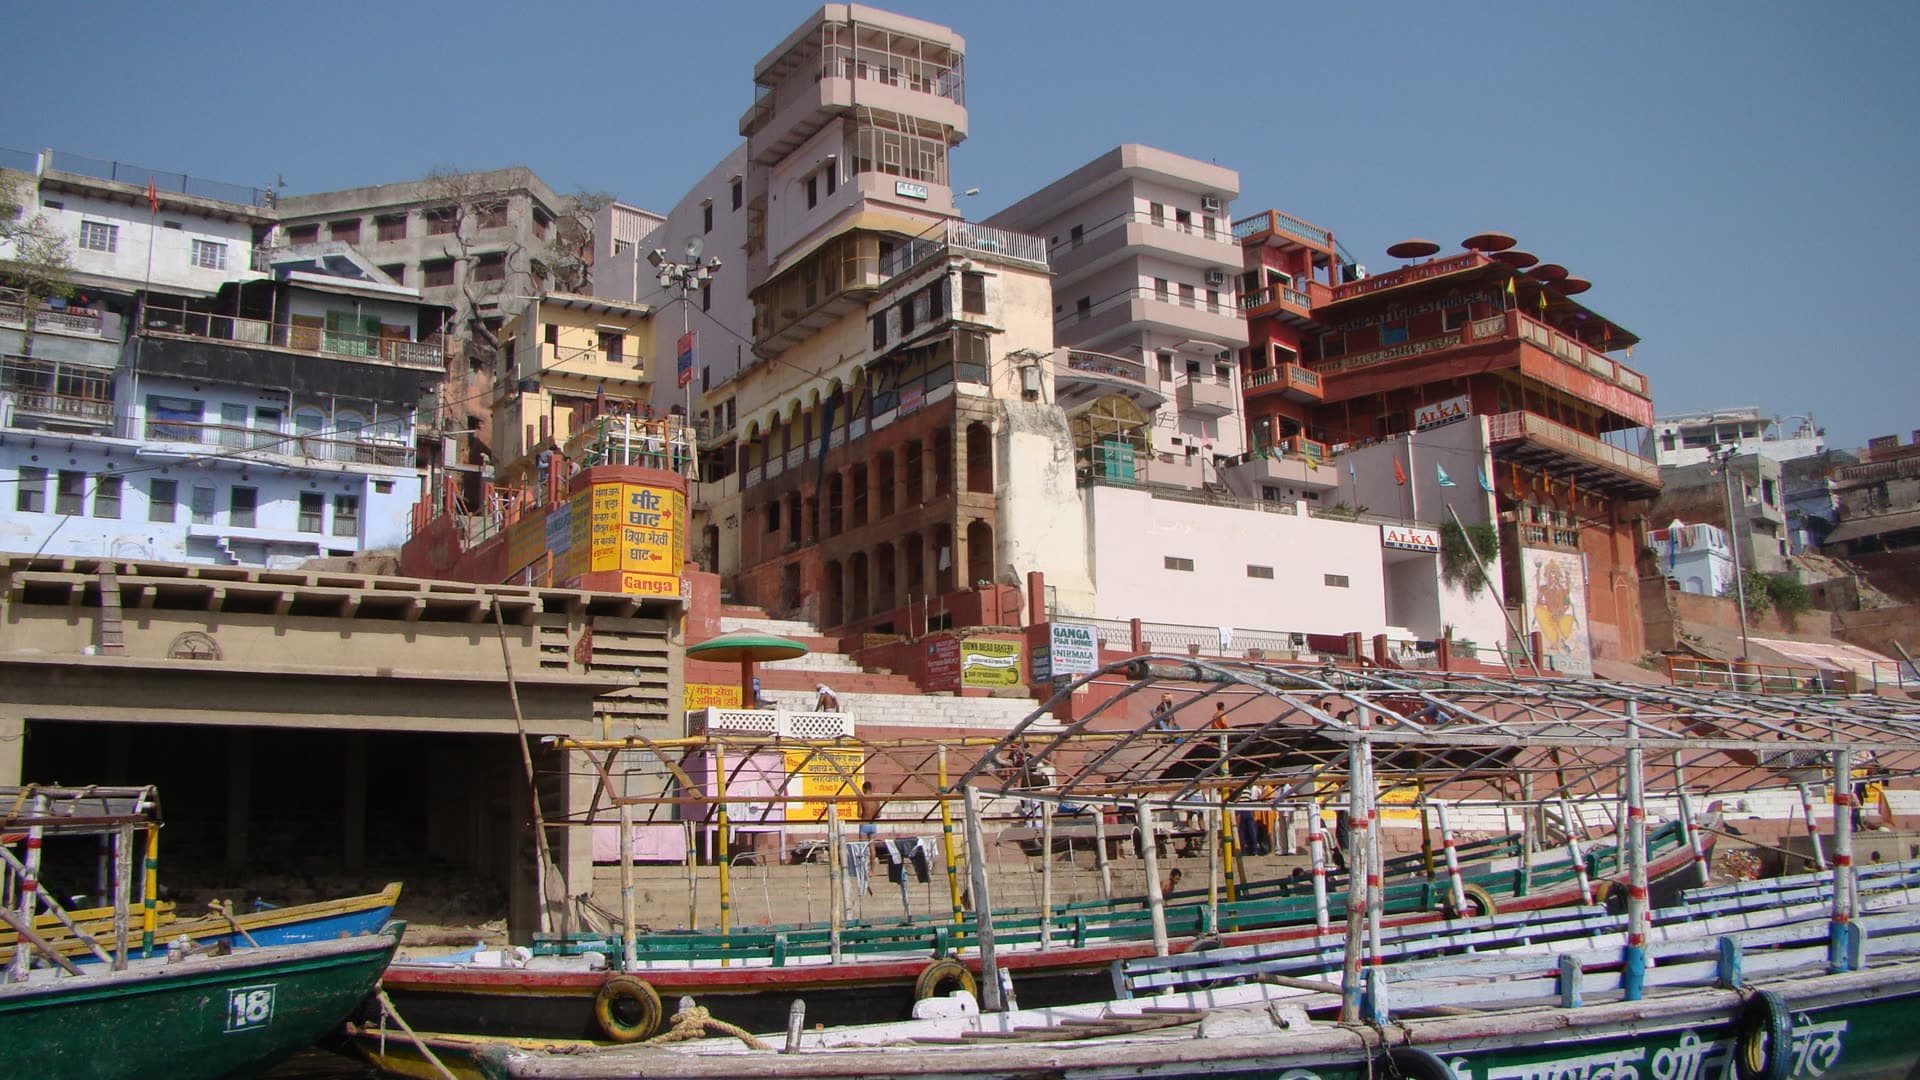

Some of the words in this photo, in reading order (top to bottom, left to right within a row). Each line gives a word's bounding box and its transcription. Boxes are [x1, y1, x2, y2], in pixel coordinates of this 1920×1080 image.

[1419, 402, 1463, 424] ALKA
[631, 489, 662, 511] मीर
[630, 511, 662, 527] घाट
[1387, 529, 1435, 546] ALKA
[624, 576, 672, 593] Ganga
[1053, 628, 1090, 640] GANGA
[1056, 649, 1093, 660] NIRMALA
[234, 990, 271, 1026] 18
